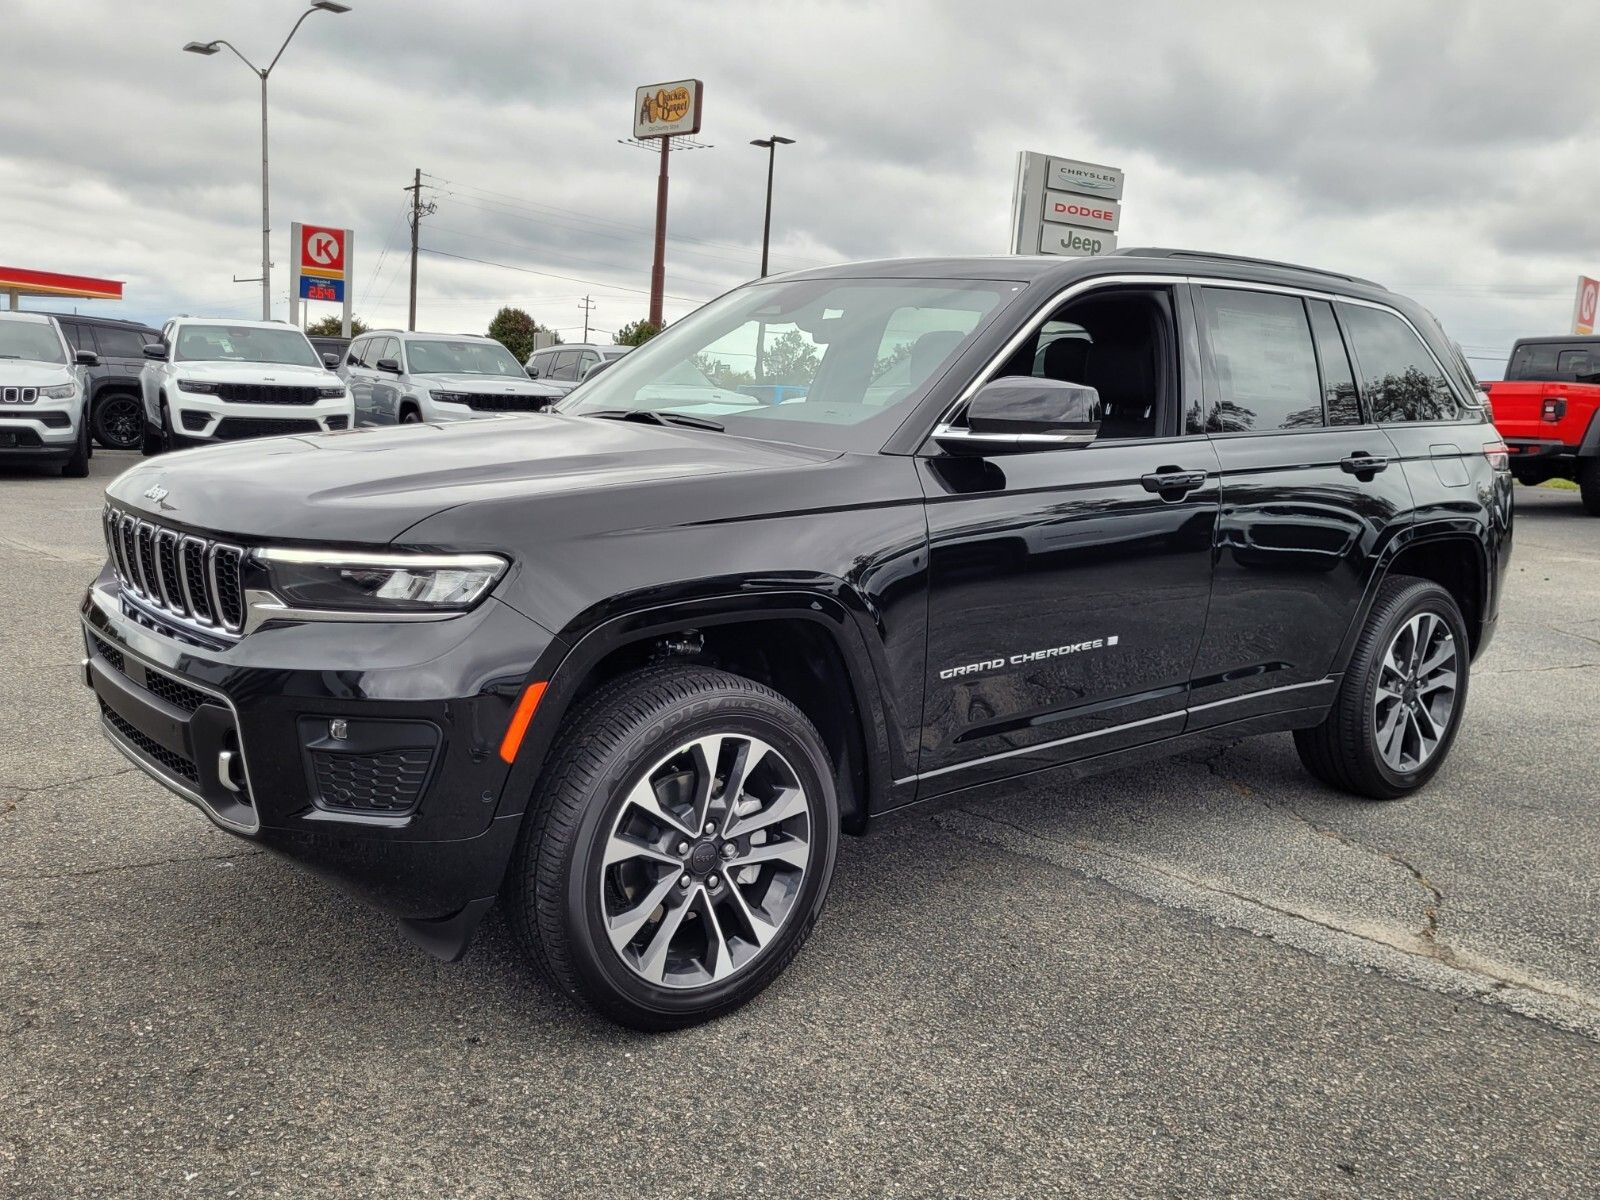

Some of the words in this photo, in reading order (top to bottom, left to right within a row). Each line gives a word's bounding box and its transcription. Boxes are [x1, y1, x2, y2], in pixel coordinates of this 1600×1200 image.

[1060, 167, 1116, 183] CHRYSLER
[1054, 202, 1114, 222] DODGE
[316, 238, 335, 261] K
[1060, 230, 1102, 256] Jeep
[939, 658, 1005, 680] GRAND
[1010, 638, 1103, 665] CHEROKEE
